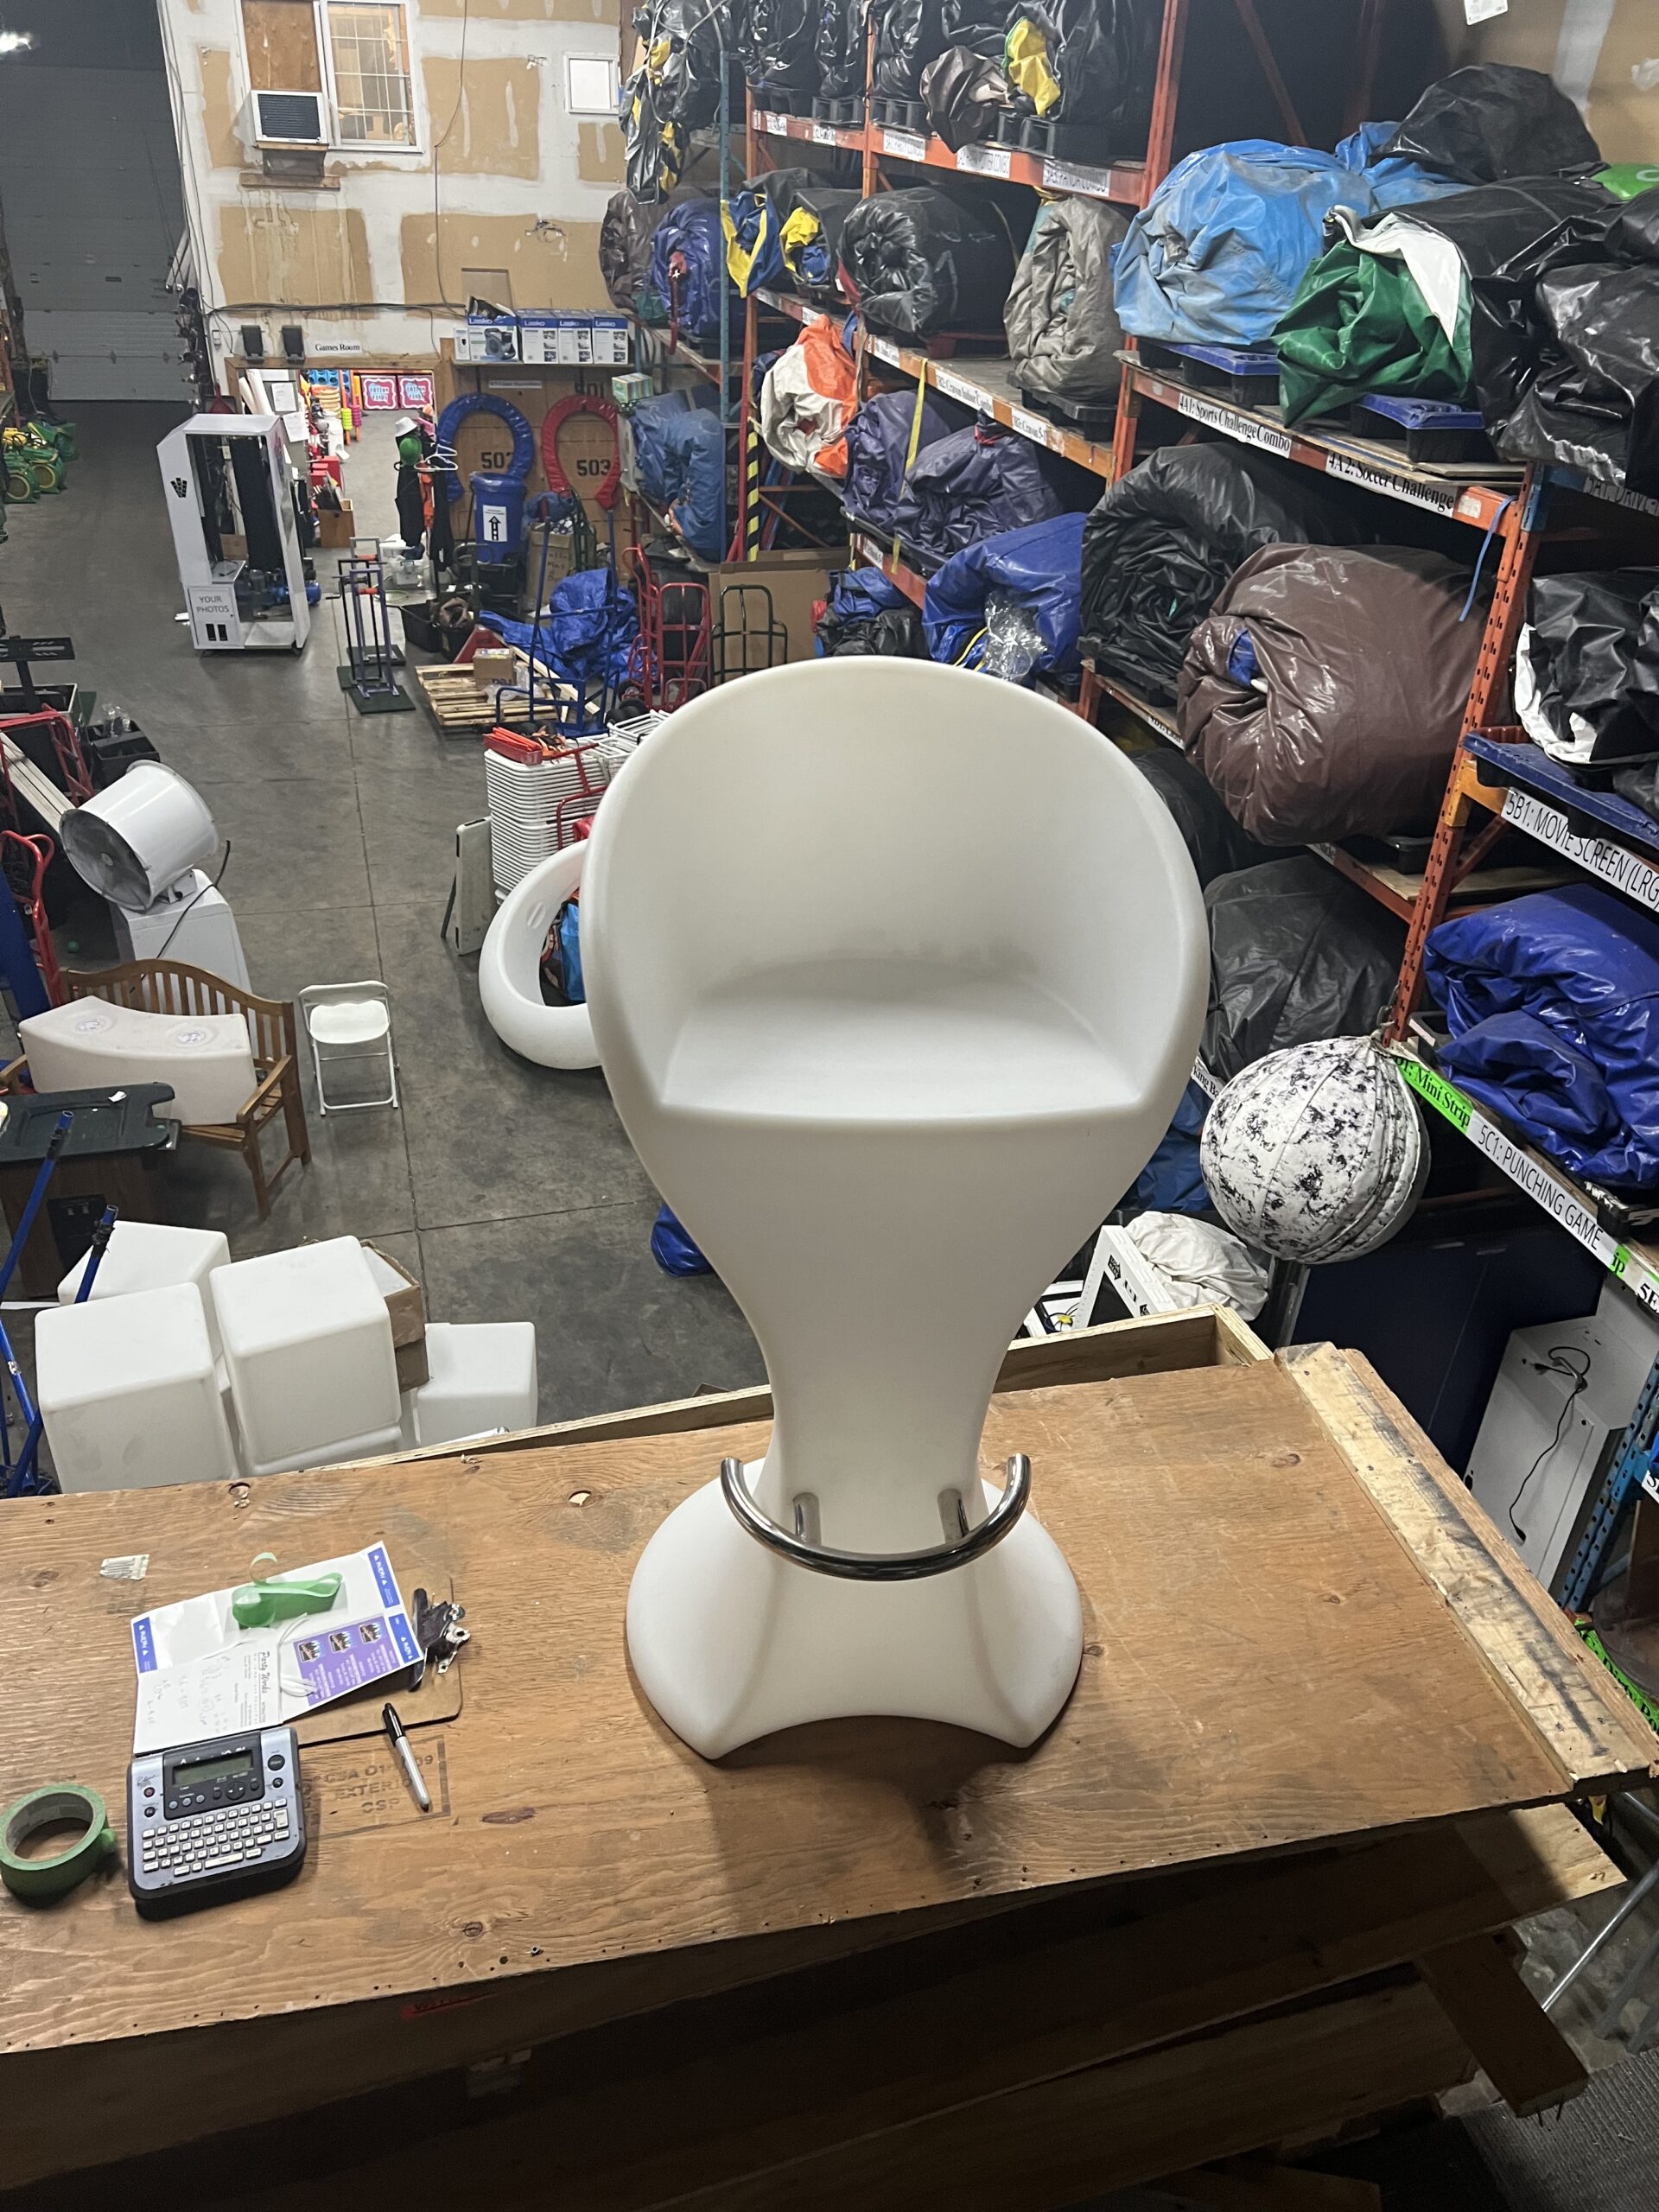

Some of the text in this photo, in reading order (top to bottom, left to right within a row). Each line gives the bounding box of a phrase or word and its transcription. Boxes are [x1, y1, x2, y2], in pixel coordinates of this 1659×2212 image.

[315, 343, 360, 352] Games Room
[1179, 394, 1290, 452] 4A1: Sports Challenge Combo
[481, 452, 513, 469] 50
[576, 459, 611, 476] 503
[1357, 460, 1392, 486] Soccer
[1392, 474, 1455, 513] Challenge
[196, 605, 230, 613] PHOTOS
[199, 595, 222, 604] YOUR
[1506, 791, 1535, 827] 5B1:
[1534, 807, 1574, 852] MOVIE
[1574, 836, 1630, 883] SCREEN
[1418, 1067, 1443, 1103] Mini
[1442, 1091, 1471, 1128] Strip
[1478, 1125, 1604, 1250] 5C1: PUNCHING GAME
[261, 1650, 270, 1671] Party
[261, 1672, 270, 1694] Works
